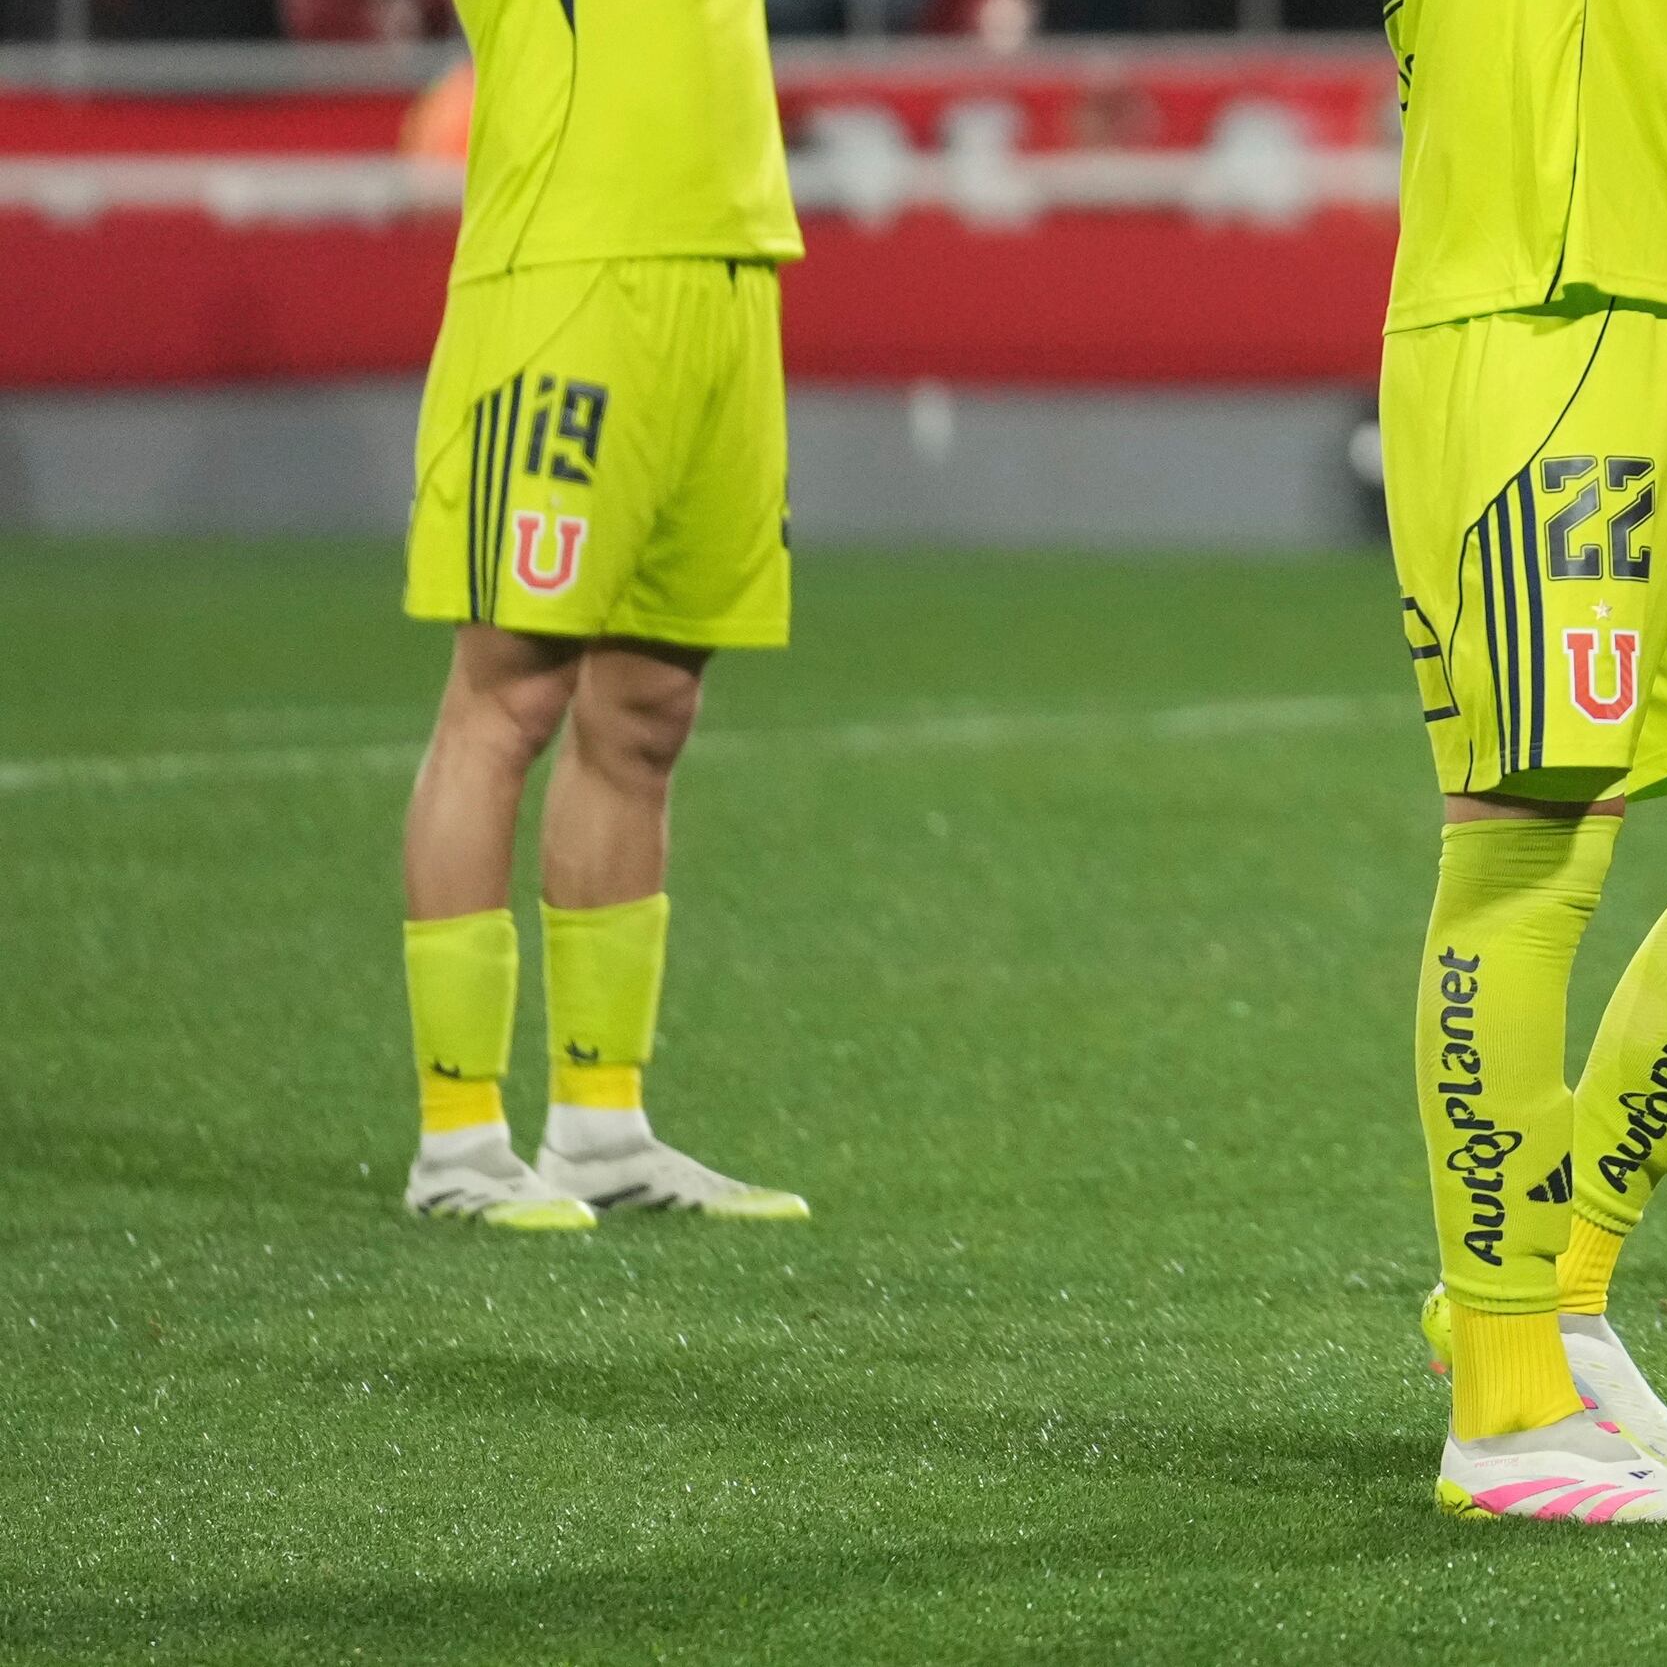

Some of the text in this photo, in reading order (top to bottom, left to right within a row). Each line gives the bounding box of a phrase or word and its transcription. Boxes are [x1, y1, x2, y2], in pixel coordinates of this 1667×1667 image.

[525, 374, 609, 487] 19
[514, 510, 589, 596] U
[1539, 454, 1656, 583] 22
[1562, 628, 1640, 725] U
